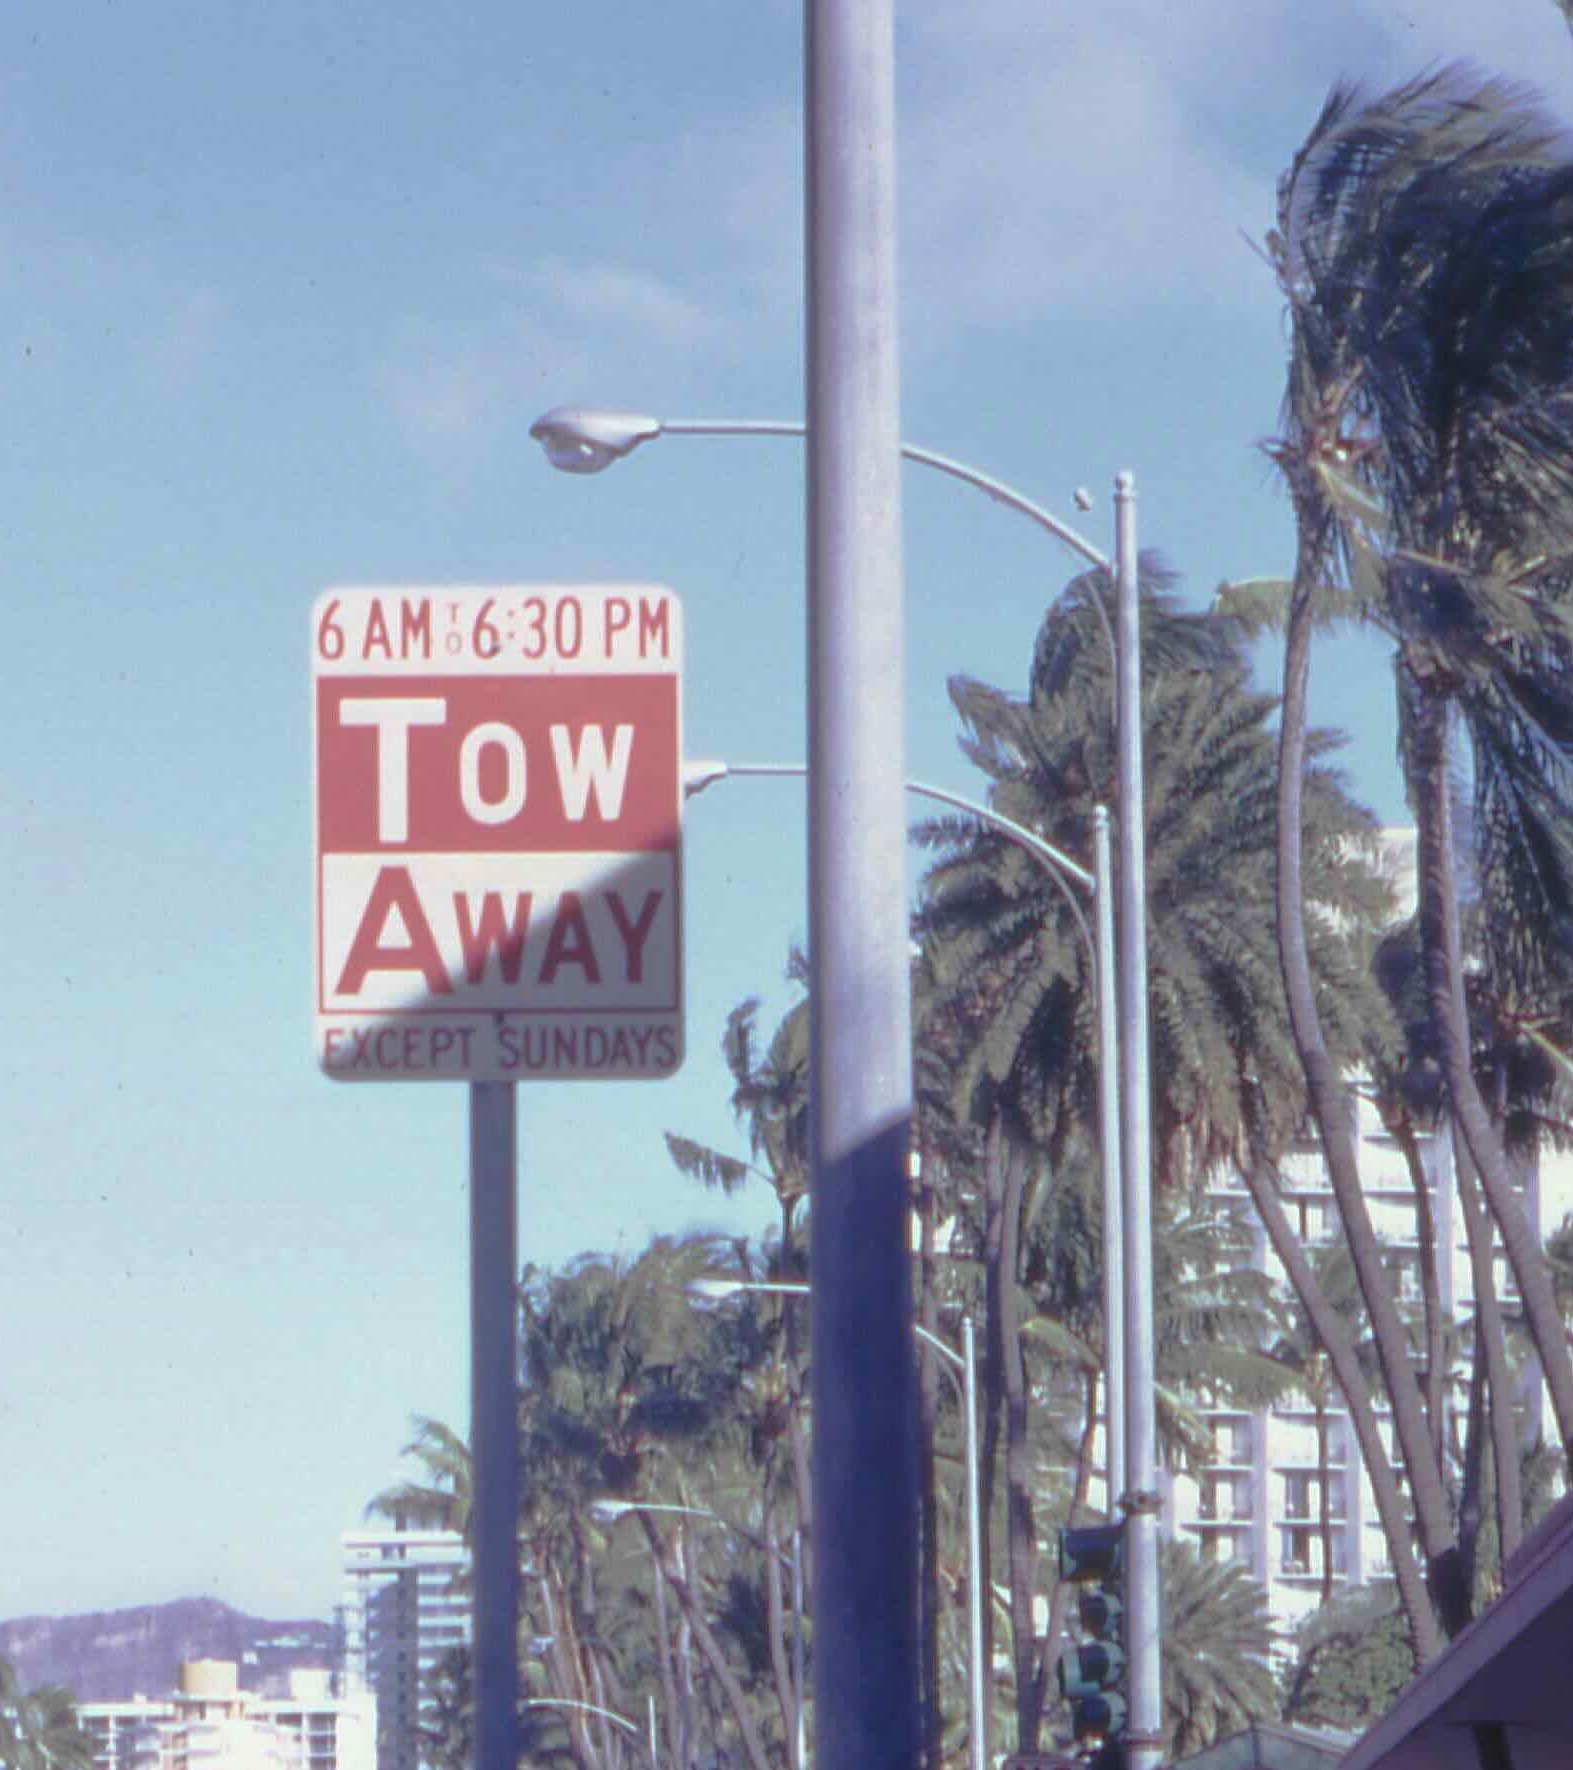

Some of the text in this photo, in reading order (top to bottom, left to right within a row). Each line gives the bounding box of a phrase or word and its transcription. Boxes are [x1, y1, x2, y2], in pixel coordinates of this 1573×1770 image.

[318, 597, 345, 661] 6
[361, 597, 432, 660] AM
[471, 596, 583, 660] 6:30
[604, 597, 671, 660] PM
[339, 697, 635, 844] TOW
[334, 865, 665, 997] AWAY
[324, 1026, 679, 1071] EXCEPT SUNDAYS
